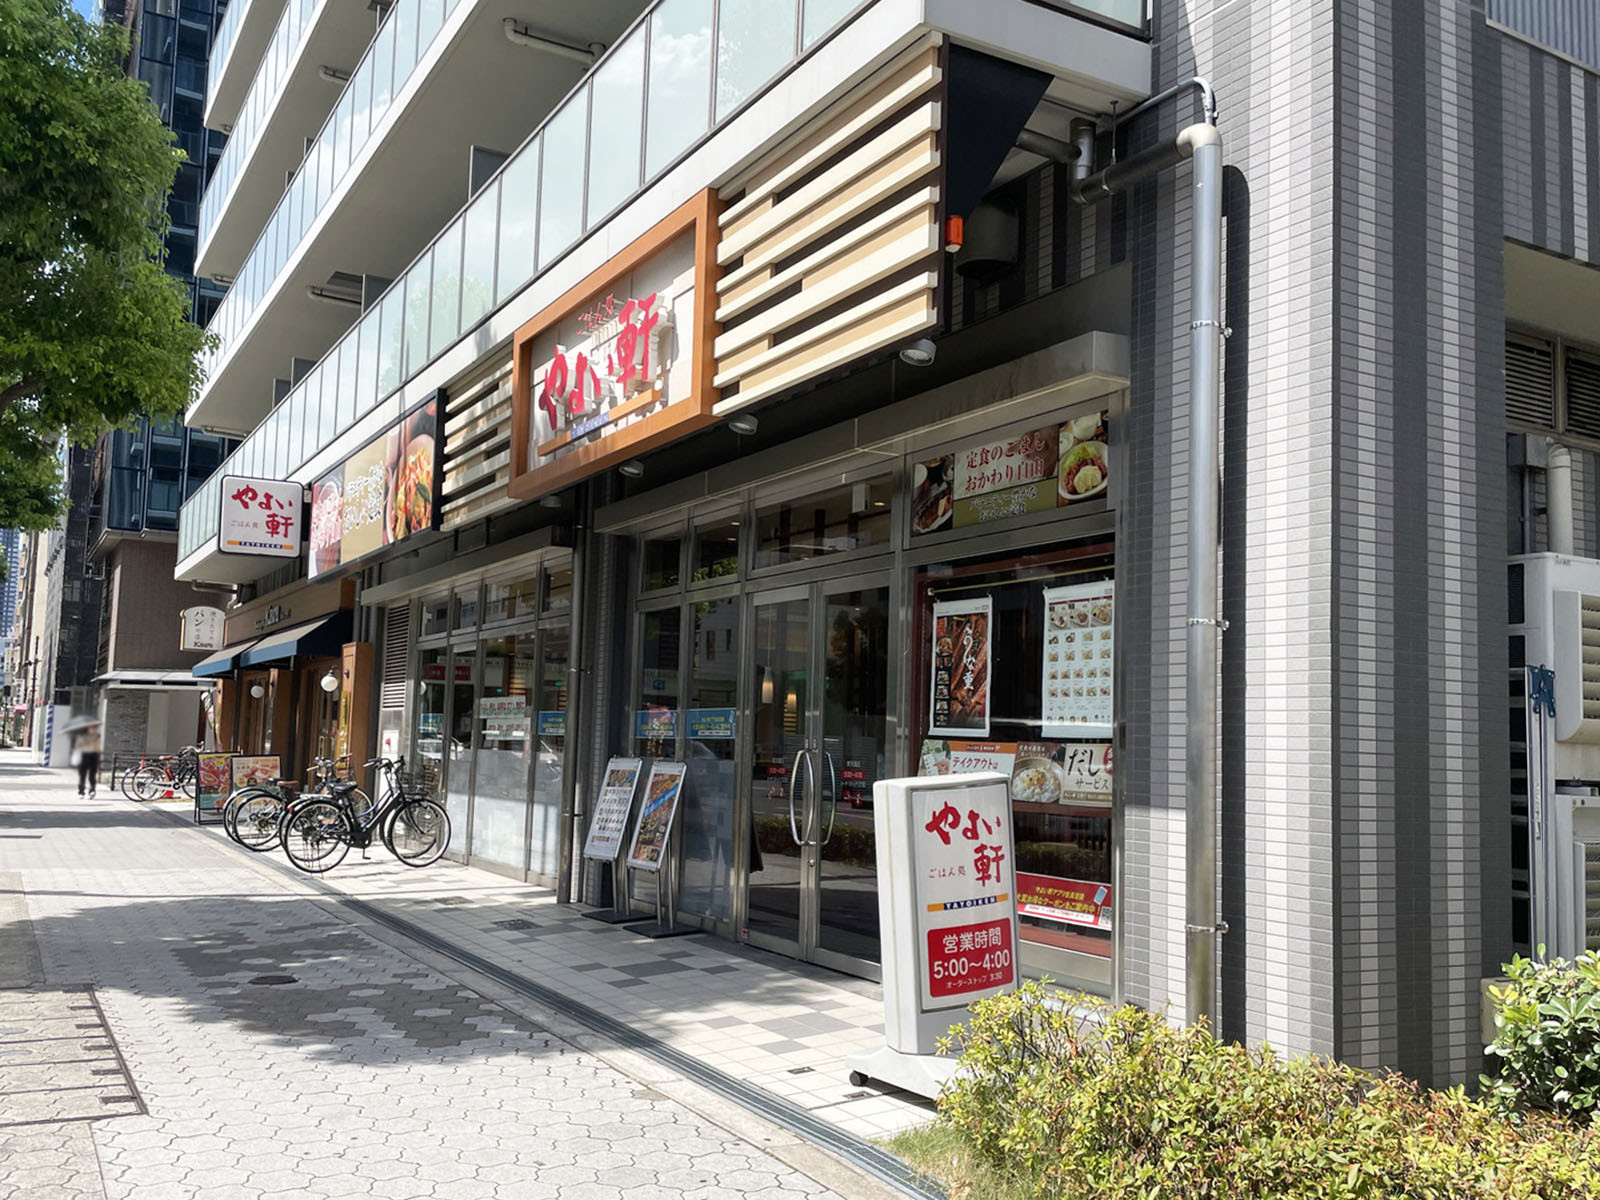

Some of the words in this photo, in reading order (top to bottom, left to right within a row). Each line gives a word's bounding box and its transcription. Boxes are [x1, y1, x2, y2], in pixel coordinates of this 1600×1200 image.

[966, 432, 1046, 470] 定食のごはん
[965, 457, 1045, 492] おかわり自由
[1068, 748, 1101, 777] だし
[1075, 778, 1109, 791] サービス
[928, 865, 967, 879] ごはん処
[945, 896, 996, 910] YAYOIKEN
[942, 926, 1002, 954] 営業時間
[946, 974, 987, 989] オーダーストップ
